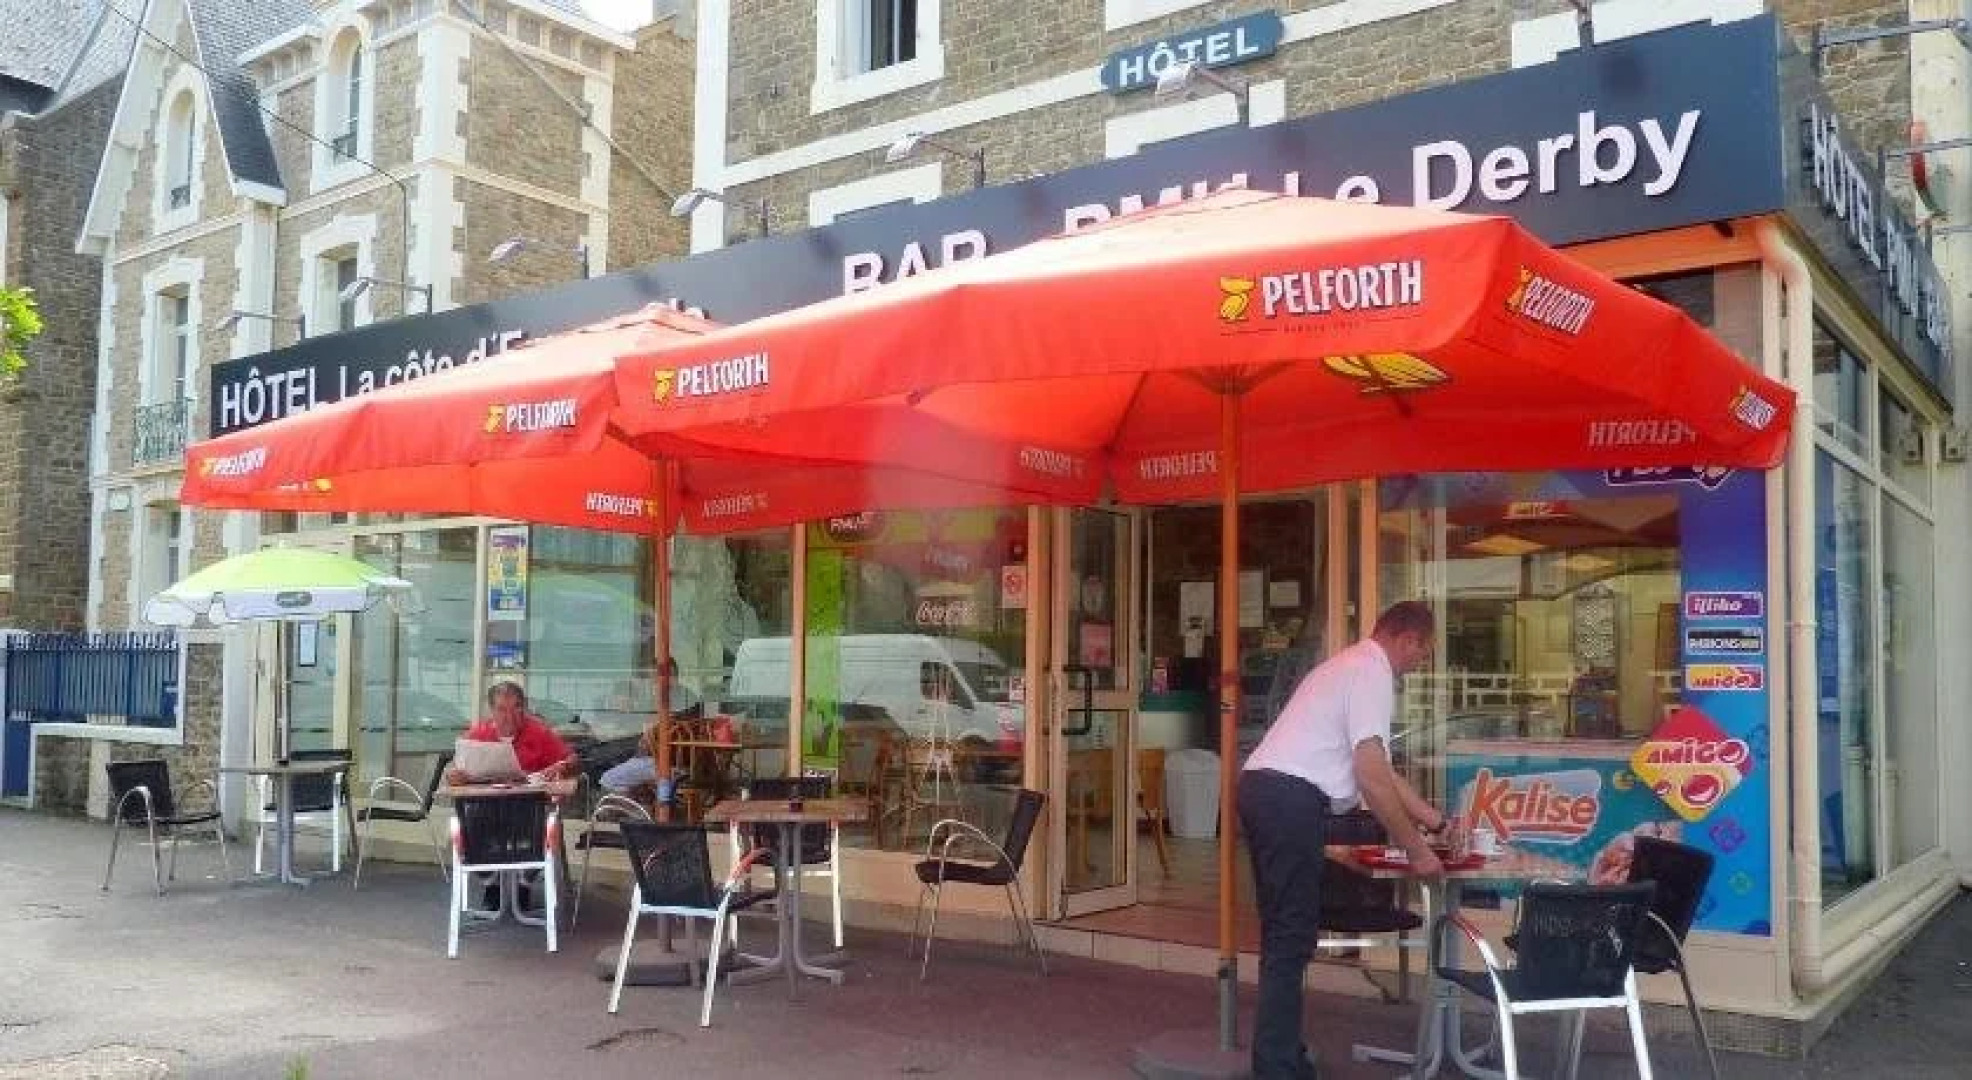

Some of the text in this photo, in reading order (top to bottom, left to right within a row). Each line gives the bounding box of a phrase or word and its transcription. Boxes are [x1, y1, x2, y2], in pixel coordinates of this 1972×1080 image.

[1119, 28, 1259, 87] HÔTEL
[1412, 110, 1700, 211] Derby
[1262, 260, 1422, 316] PELFORTH
[219, 366, 328, 428] HÔTEL
[677, 352, 769, 398] PELFORTH
[1465, 768, 1599, 842] Kalise
